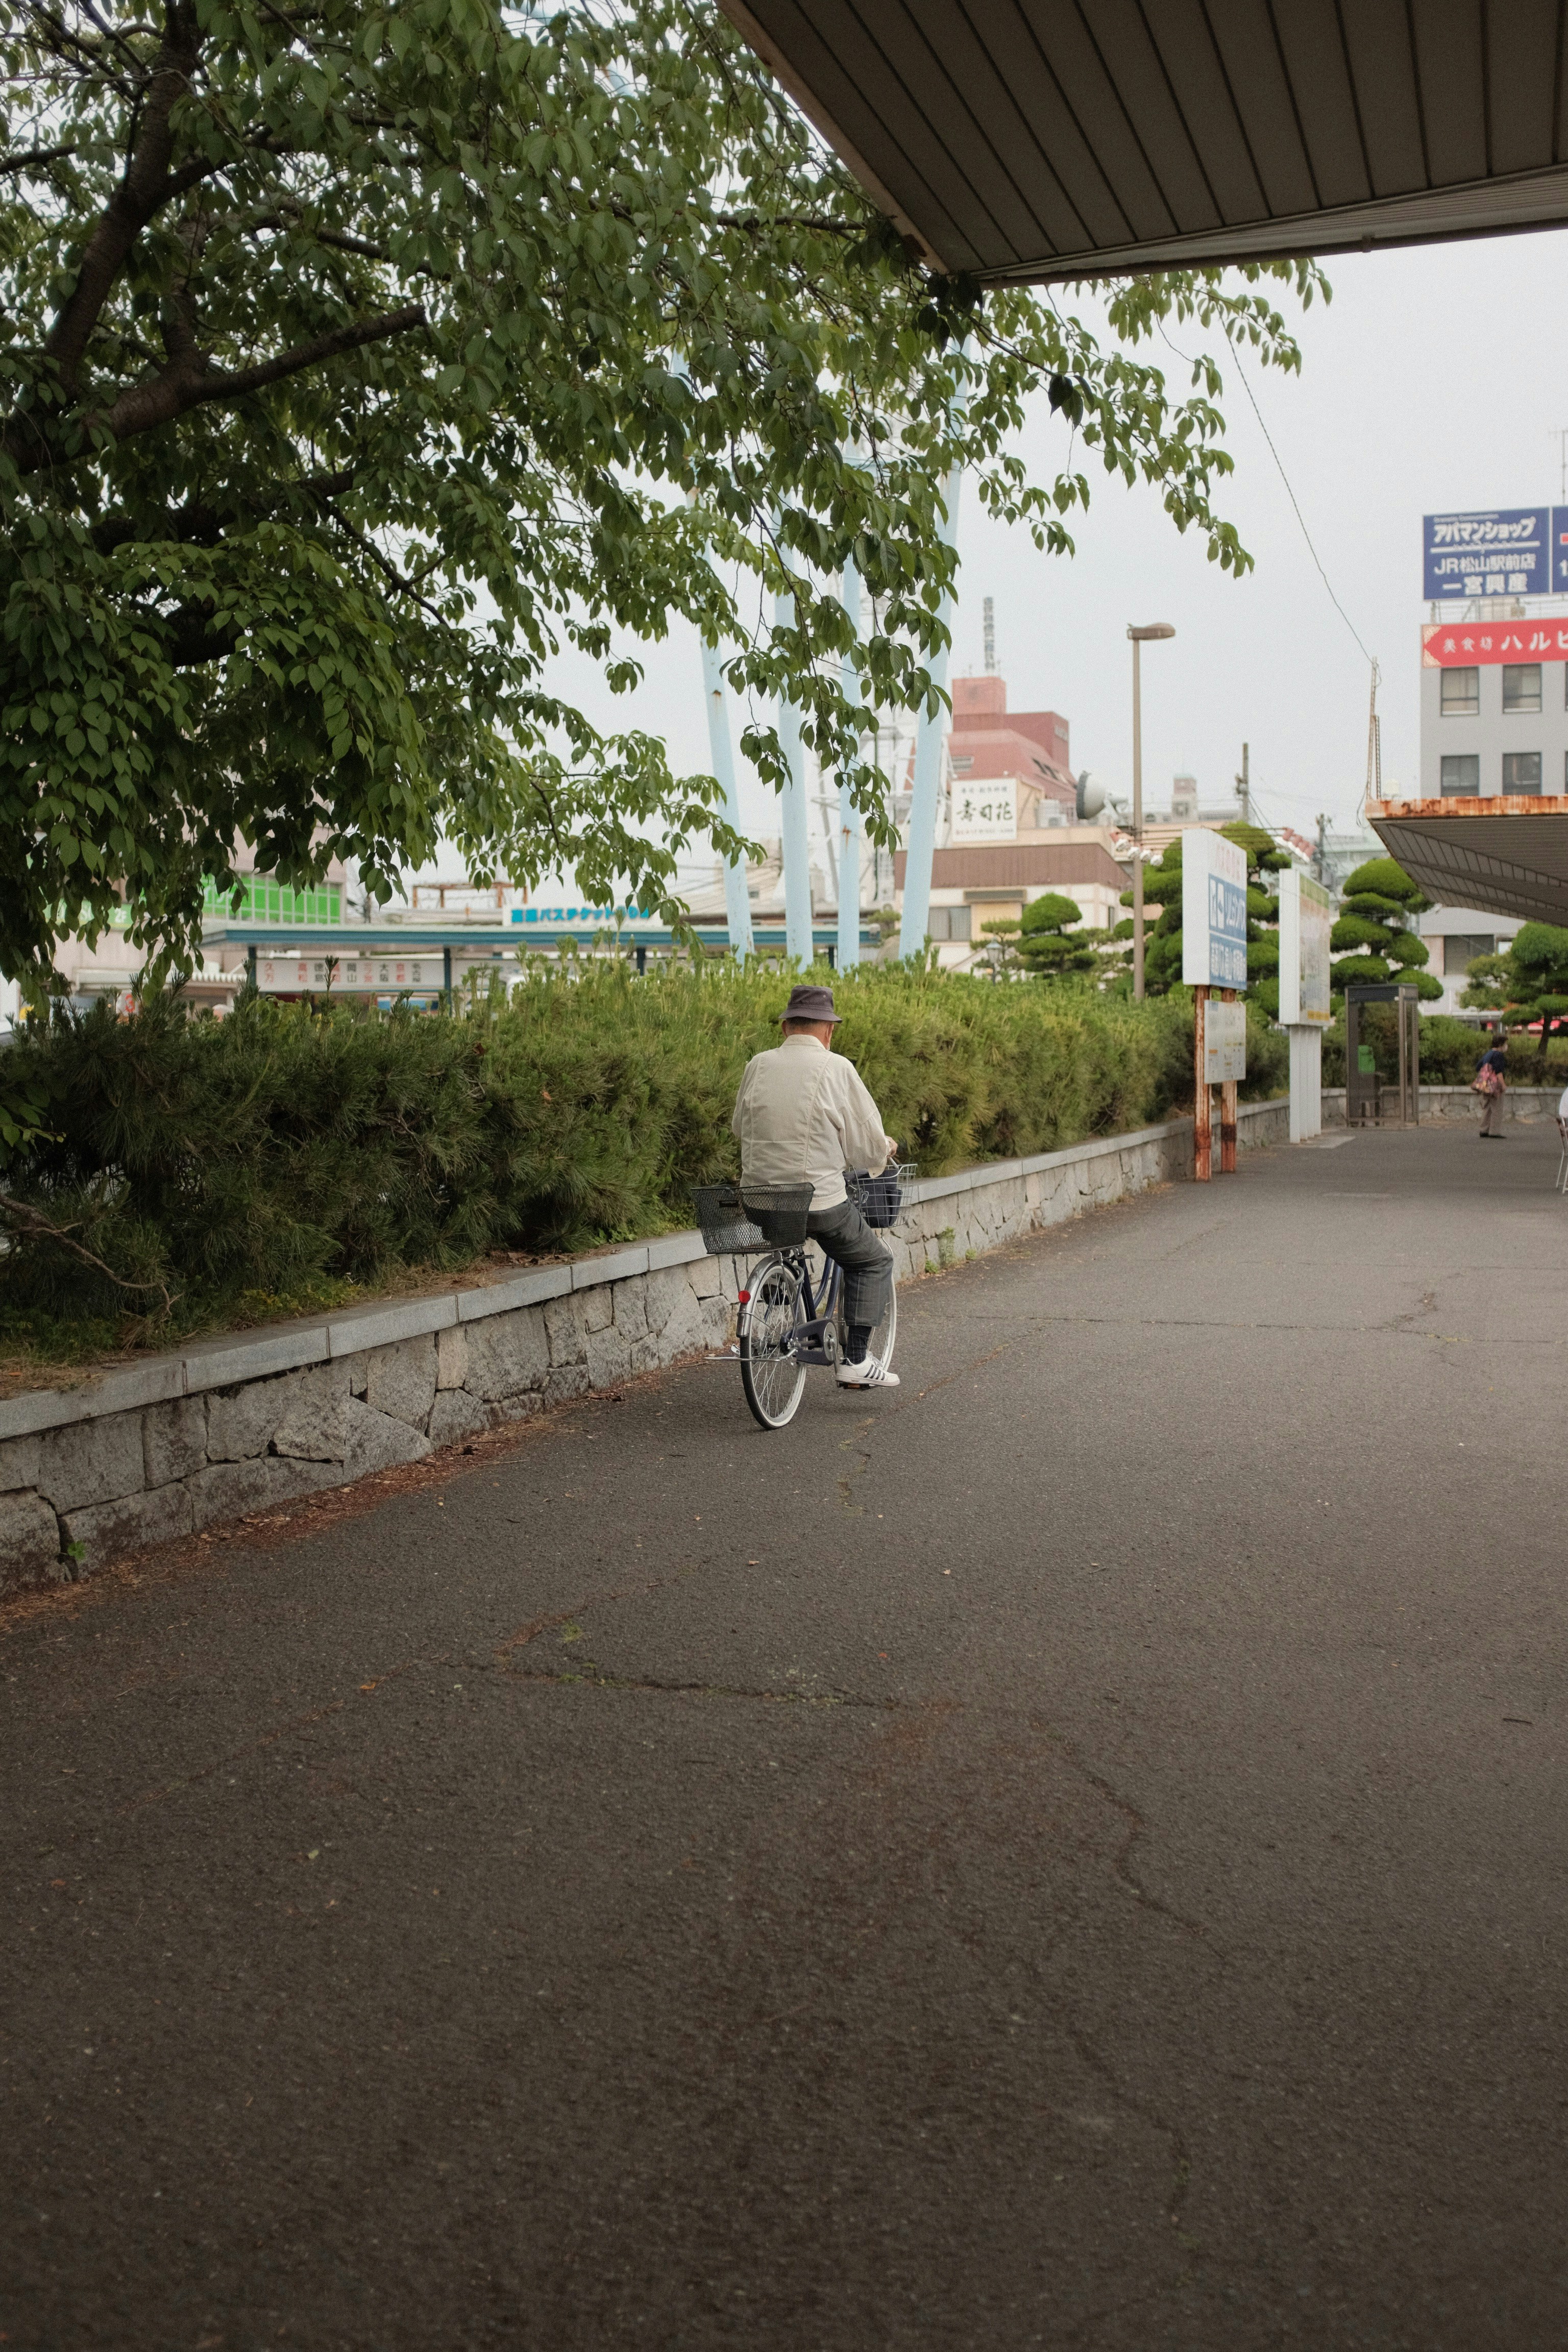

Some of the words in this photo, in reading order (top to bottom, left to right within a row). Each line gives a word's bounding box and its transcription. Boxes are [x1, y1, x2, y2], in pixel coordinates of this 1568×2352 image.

[1434, 516, 1536, 543] アパマンショップ
[1434, 553, 1536, 575] JR松山駅前店
[1442, 572, 1528, 596] 一宮興産
[347, 962, 357, 983] 岡山
